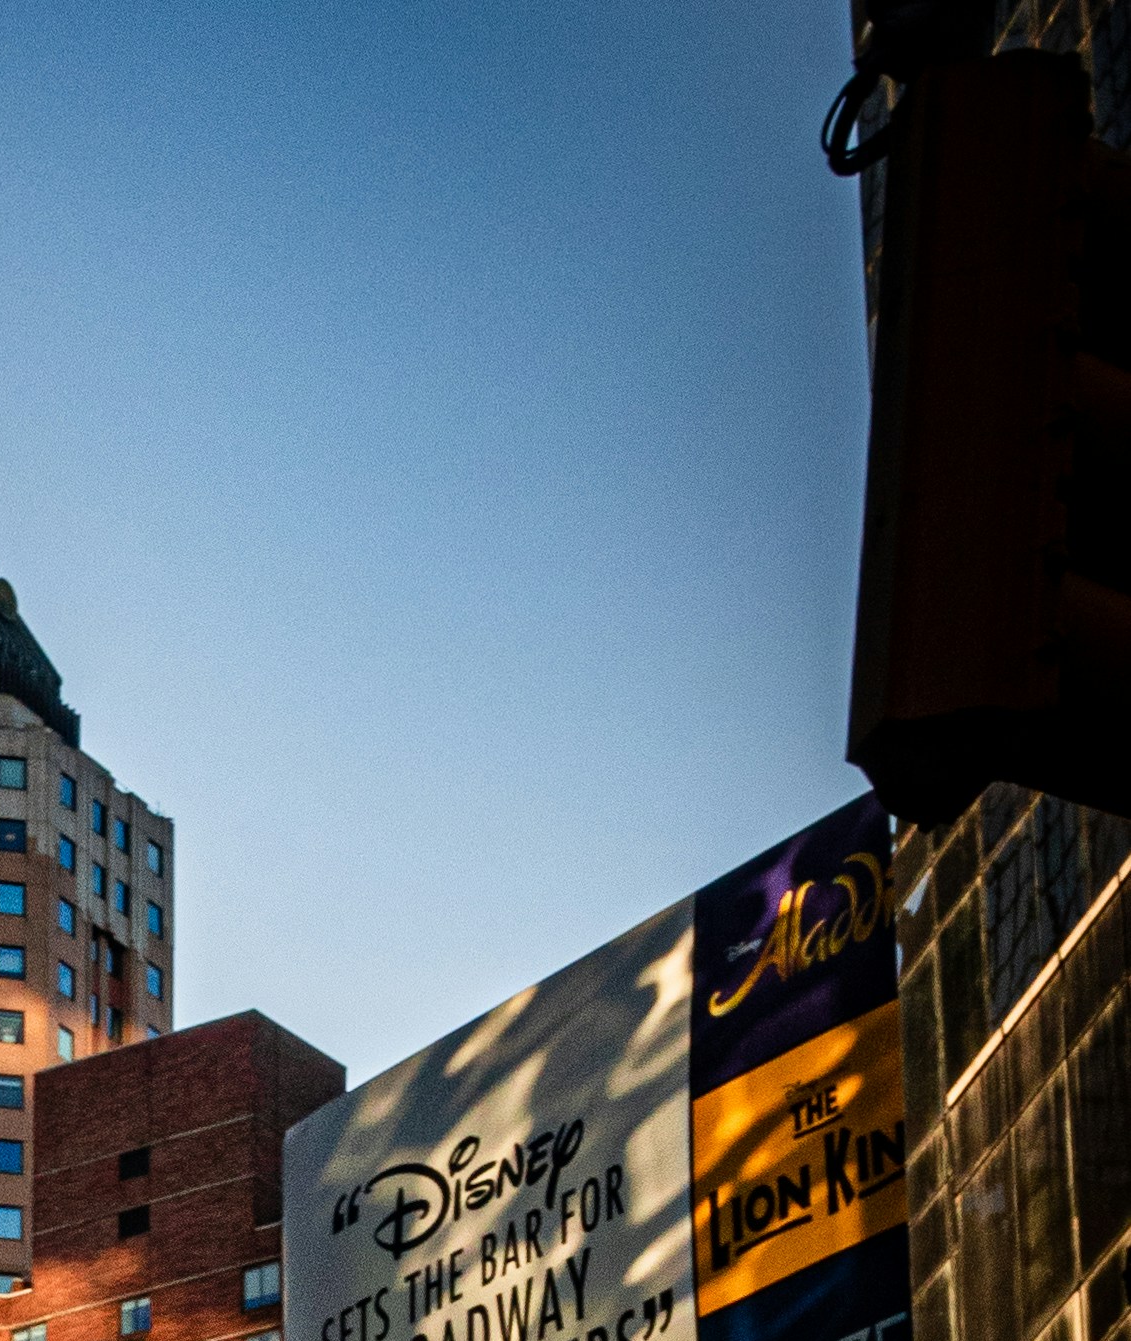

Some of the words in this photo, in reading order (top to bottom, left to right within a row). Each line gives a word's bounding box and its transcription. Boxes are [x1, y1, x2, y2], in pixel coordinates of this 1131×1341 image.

[790, 1085, 838, 1132] THE
[403, 1248, 464, 1324] THE
[481, 1208, 543, 1287] BAR
[559, 1163, 626, 1245] FOR
[710, 1164, 811, 1269] LION
